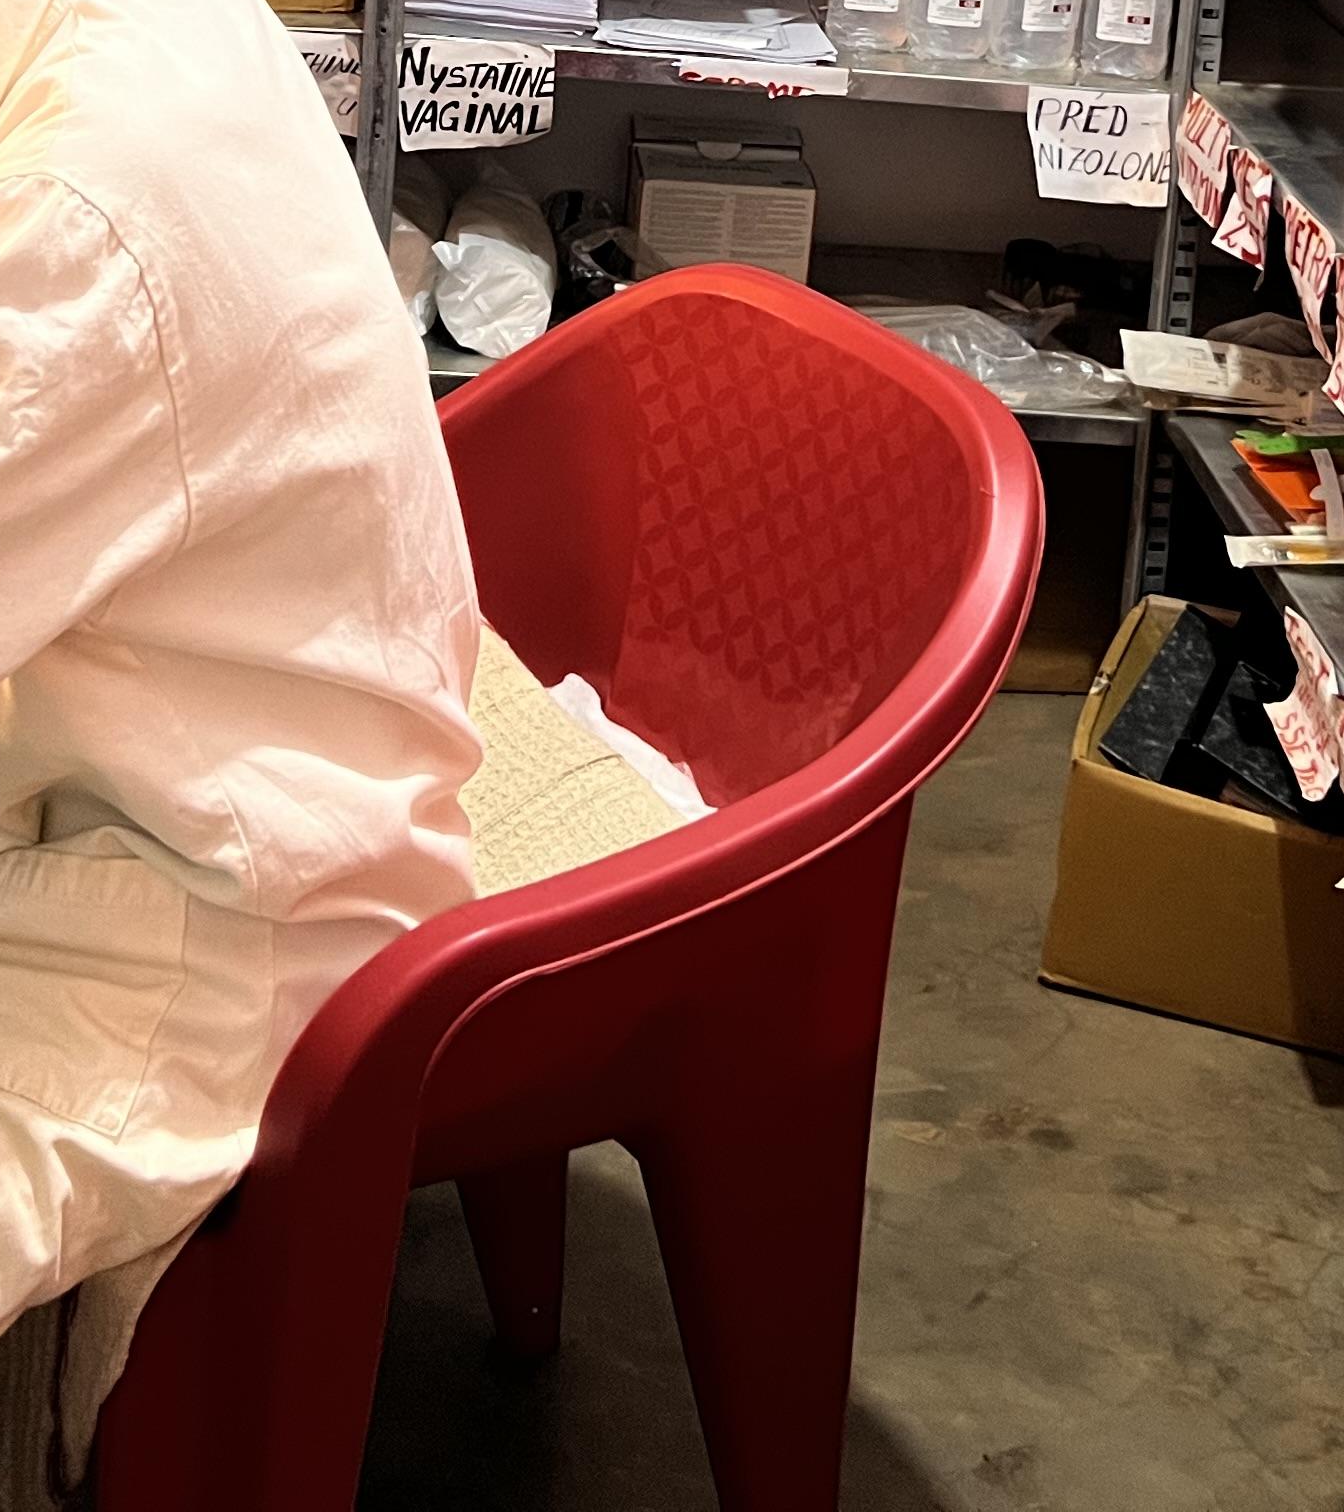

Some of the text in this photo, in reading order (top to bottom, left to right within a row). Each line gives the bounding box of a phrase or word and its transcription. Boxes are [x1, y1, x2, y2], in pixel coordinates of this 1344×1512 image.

[398, 46, 555, 98] NYSTATINE
[400, 92, 550, 137] VAGINAL
[1038, 138, 1174, 186] NIZOLONE
